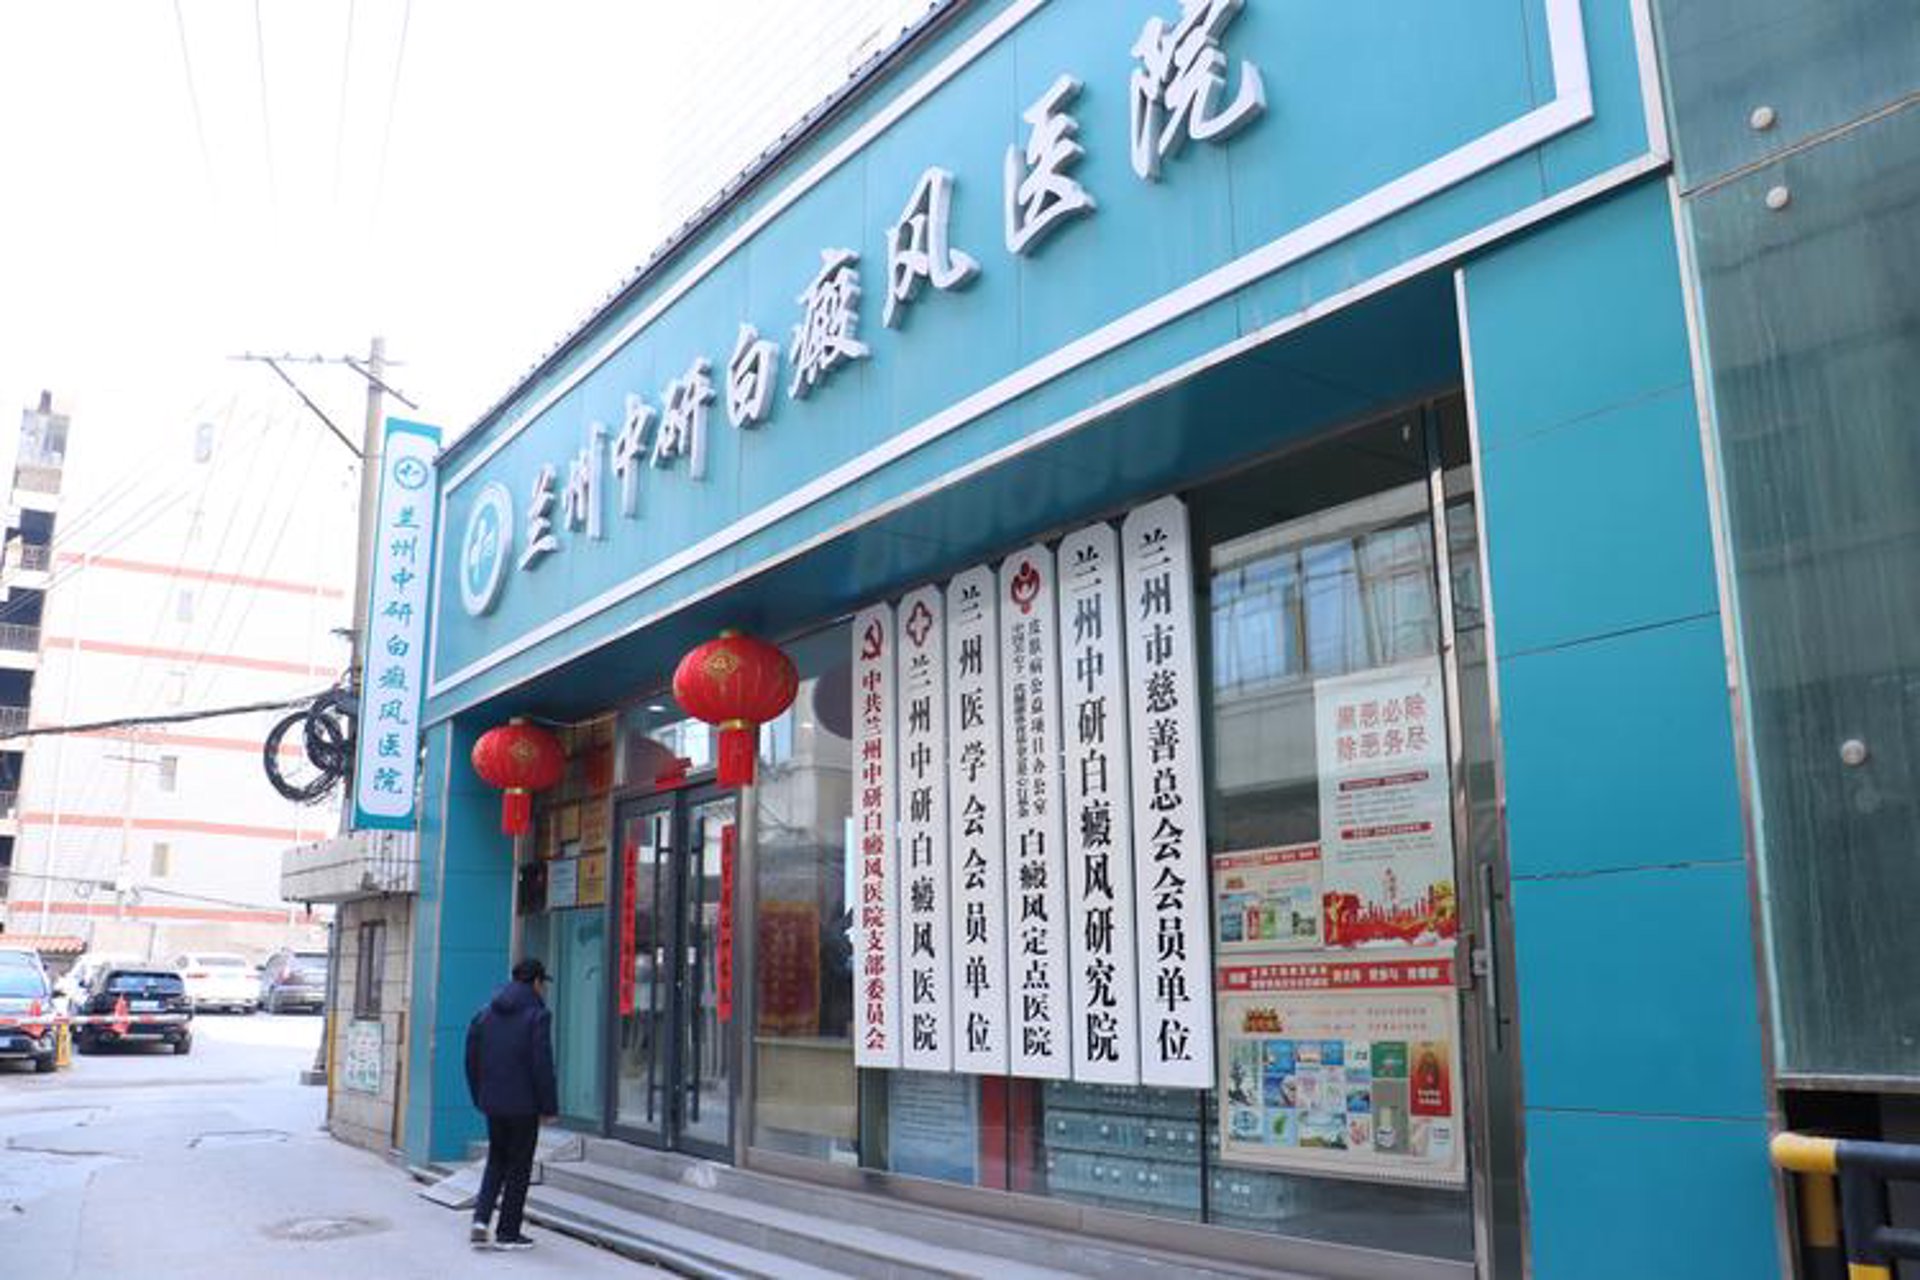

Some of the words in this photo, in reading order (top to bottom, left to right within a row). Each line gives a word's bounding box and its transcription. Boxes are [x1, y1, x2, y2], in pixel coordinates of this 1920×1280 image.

[372, 505, 421, 795] 兰州中研白癜风医院
[958, 585, 992, 1052] 兰州医学会会员单位
[1072, 545, 1119, 1062] 兰州中研白癜风研究院
[1138, 527, 1192, 1063] 兰州市慈善总会会员单位
[862, 669, 886, 1051] 中共兰州中研白癜风医院支部委员会
[907, 654, 938, 1051] 兰州中研白癜风医院
[1018, 828, 1053, 1058] 白癜风定点医院
